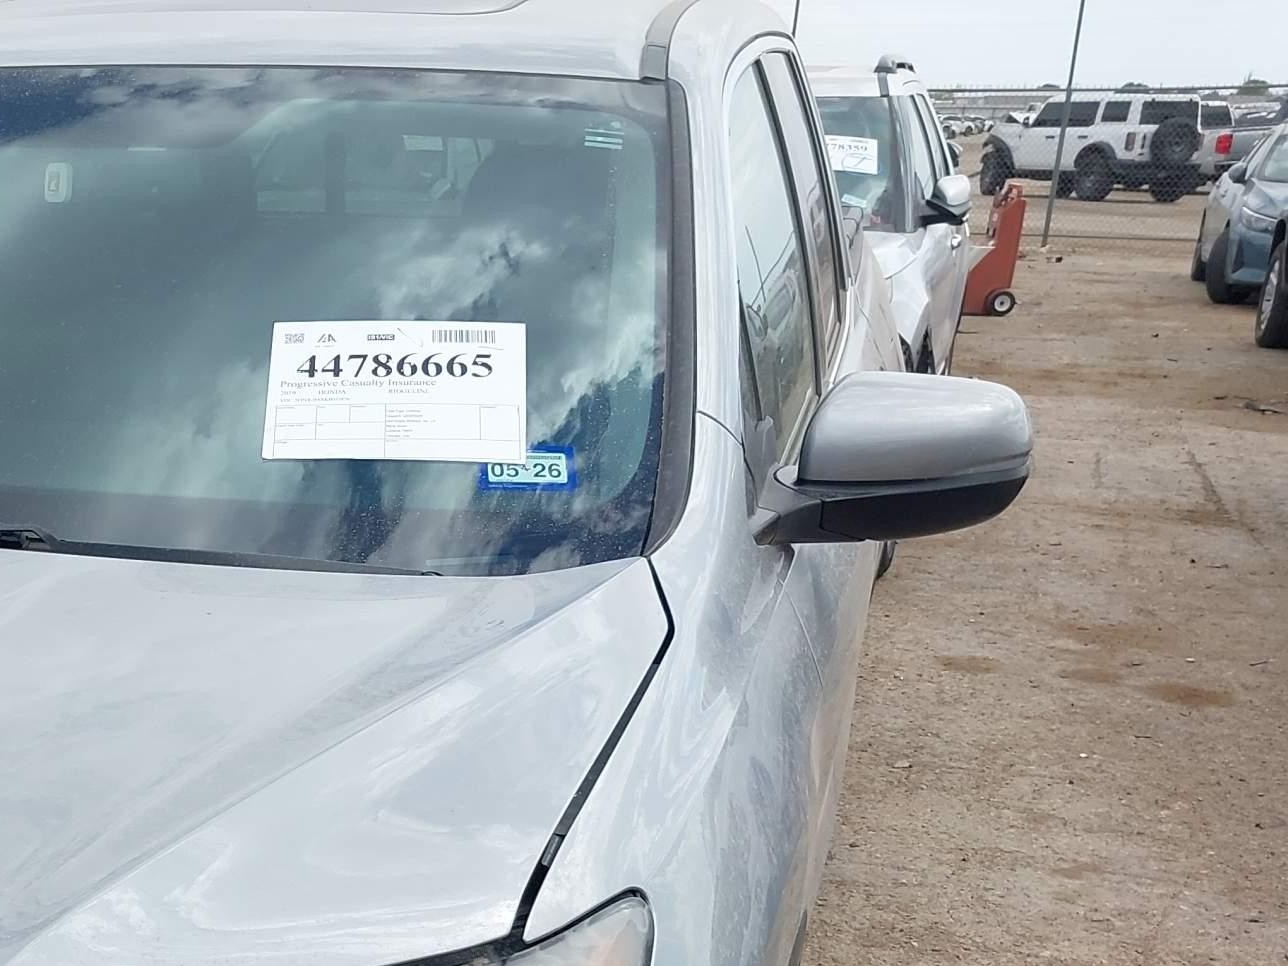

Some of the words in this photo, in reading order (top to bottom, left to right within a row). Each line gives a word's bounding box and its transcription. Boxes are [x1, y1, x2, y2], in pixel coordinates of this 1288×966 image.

[296, 352, 494, 378] 44786665
[280, 380, 339, 390] Progressive
[340, 379, 385, 388] Casualty
[387, 379, 438, 387] Insurance
[490, 463, 520, 478] 05
[532, 462, 562, 478] 26
